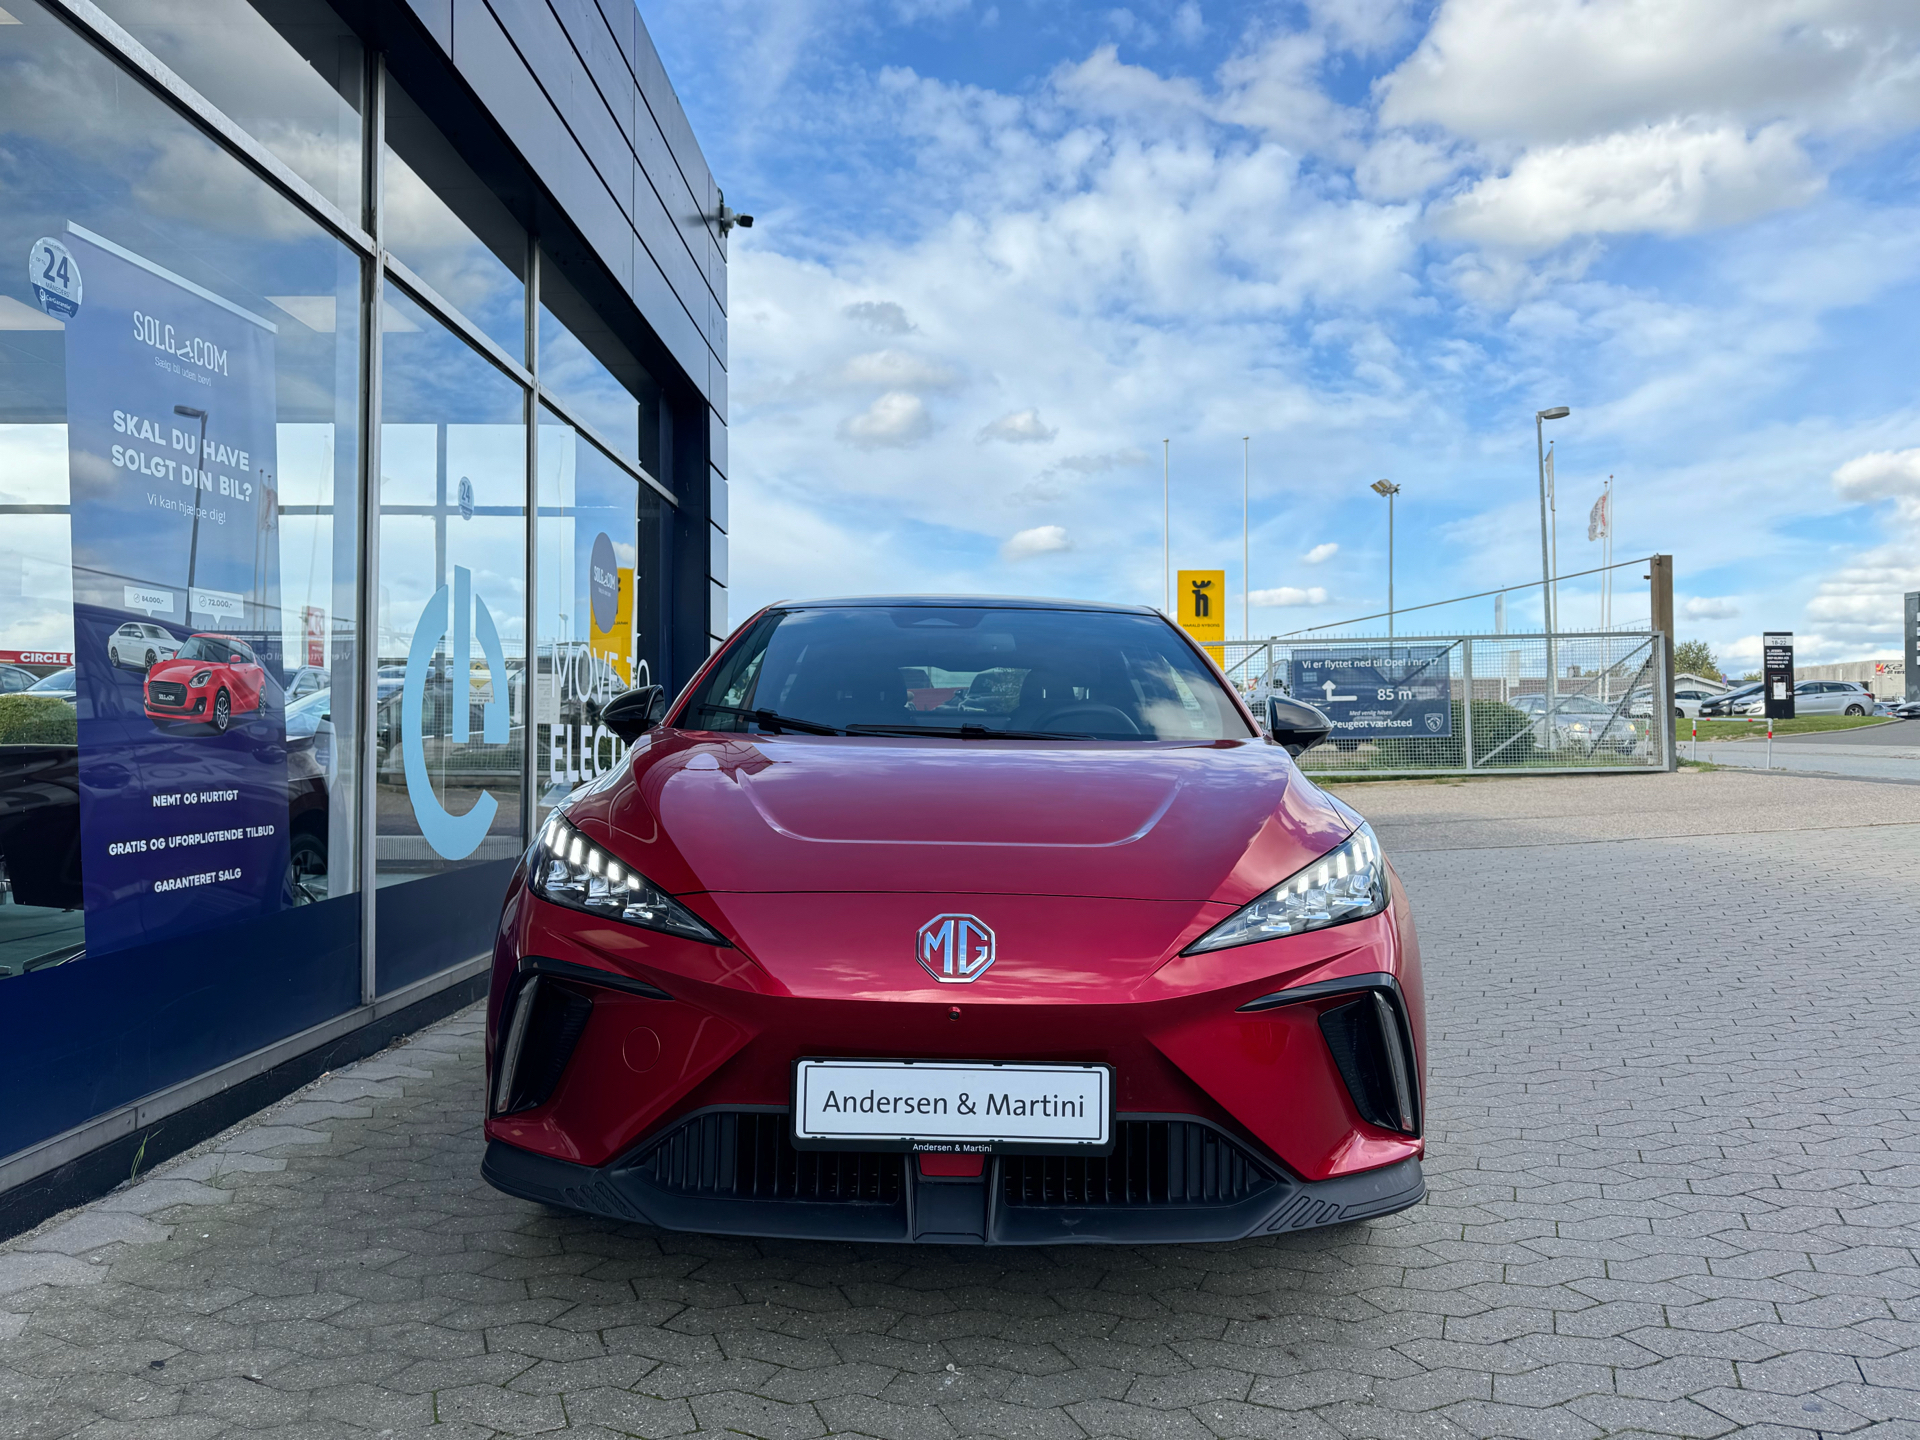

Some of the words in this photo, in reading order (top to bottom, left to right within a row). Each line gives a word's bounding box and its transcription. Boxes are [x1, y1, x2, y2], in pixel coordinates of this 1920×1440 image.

[43, 247, 70, 289] 24
[113, 410, 166, 446] SKAL
[172, 428, 196, 455] DU
[202, 439, 250, 472] HAVE
[112, 444, 176, 481] SOLGT
[182, 464, 212, 492] DIN
[220, 475, 252, 502] BIL?
[147, 492, 157, 506] Vi
[160, 495, 176, 511] kan
[179, 500, 207, 520] hjælpe
[210, 508, 226, 525] dig!
[208, 598, 232, 609] 72.000,-
[20, 652, 68, 664] CIRCLE
[552, 640, 618, 704] MOVE
[626, 656, 650, 691] TO
[1302, 660, 1312, 669] Vi
[1324, 660, 1352, 670] flyttet
[1354, 659, 1372, 668] ned
[1373, 658, 1382, 667] til
[1384, 658, 1406, 669] Opel
[1412, 658, 1426, 666] nr.
[1428, 658, 1438, 666] 17
[1377, 688, 1394, 700] 85
[1398, 690, 1412, 700] m
[1332, 720, 1368, 730] Peugeot
[1370, 718, 1412, 728] værksted
[550, 724, 628, 784] ELECT
[152, 794, 181, 807] NEMT
[184, 792, 198, 804] OG
[200, 790, 238, 804] HURTIGT
[108, 840, 148, 856] GRATIS
[150, 838, 166, 850] OG
[168, 828, 244, 848] UFORPLIGTENDE
[246, 824, 274, 839] TILBUD
[154, 872, 216, 892] GARANTERET
[218, 868, 242, 882] SALG
[924, 920, 988, 975] MG
[822, 1090, 948, 1115] Andersen
[956, 1092, 977, 1116] &
[986, 1094, 1085, 1118] Martini
[912, 1142, 952, 1152] Andersen
[954, 1144, 961, 1152] &
[963, 1144, 992, 1152] Martini
